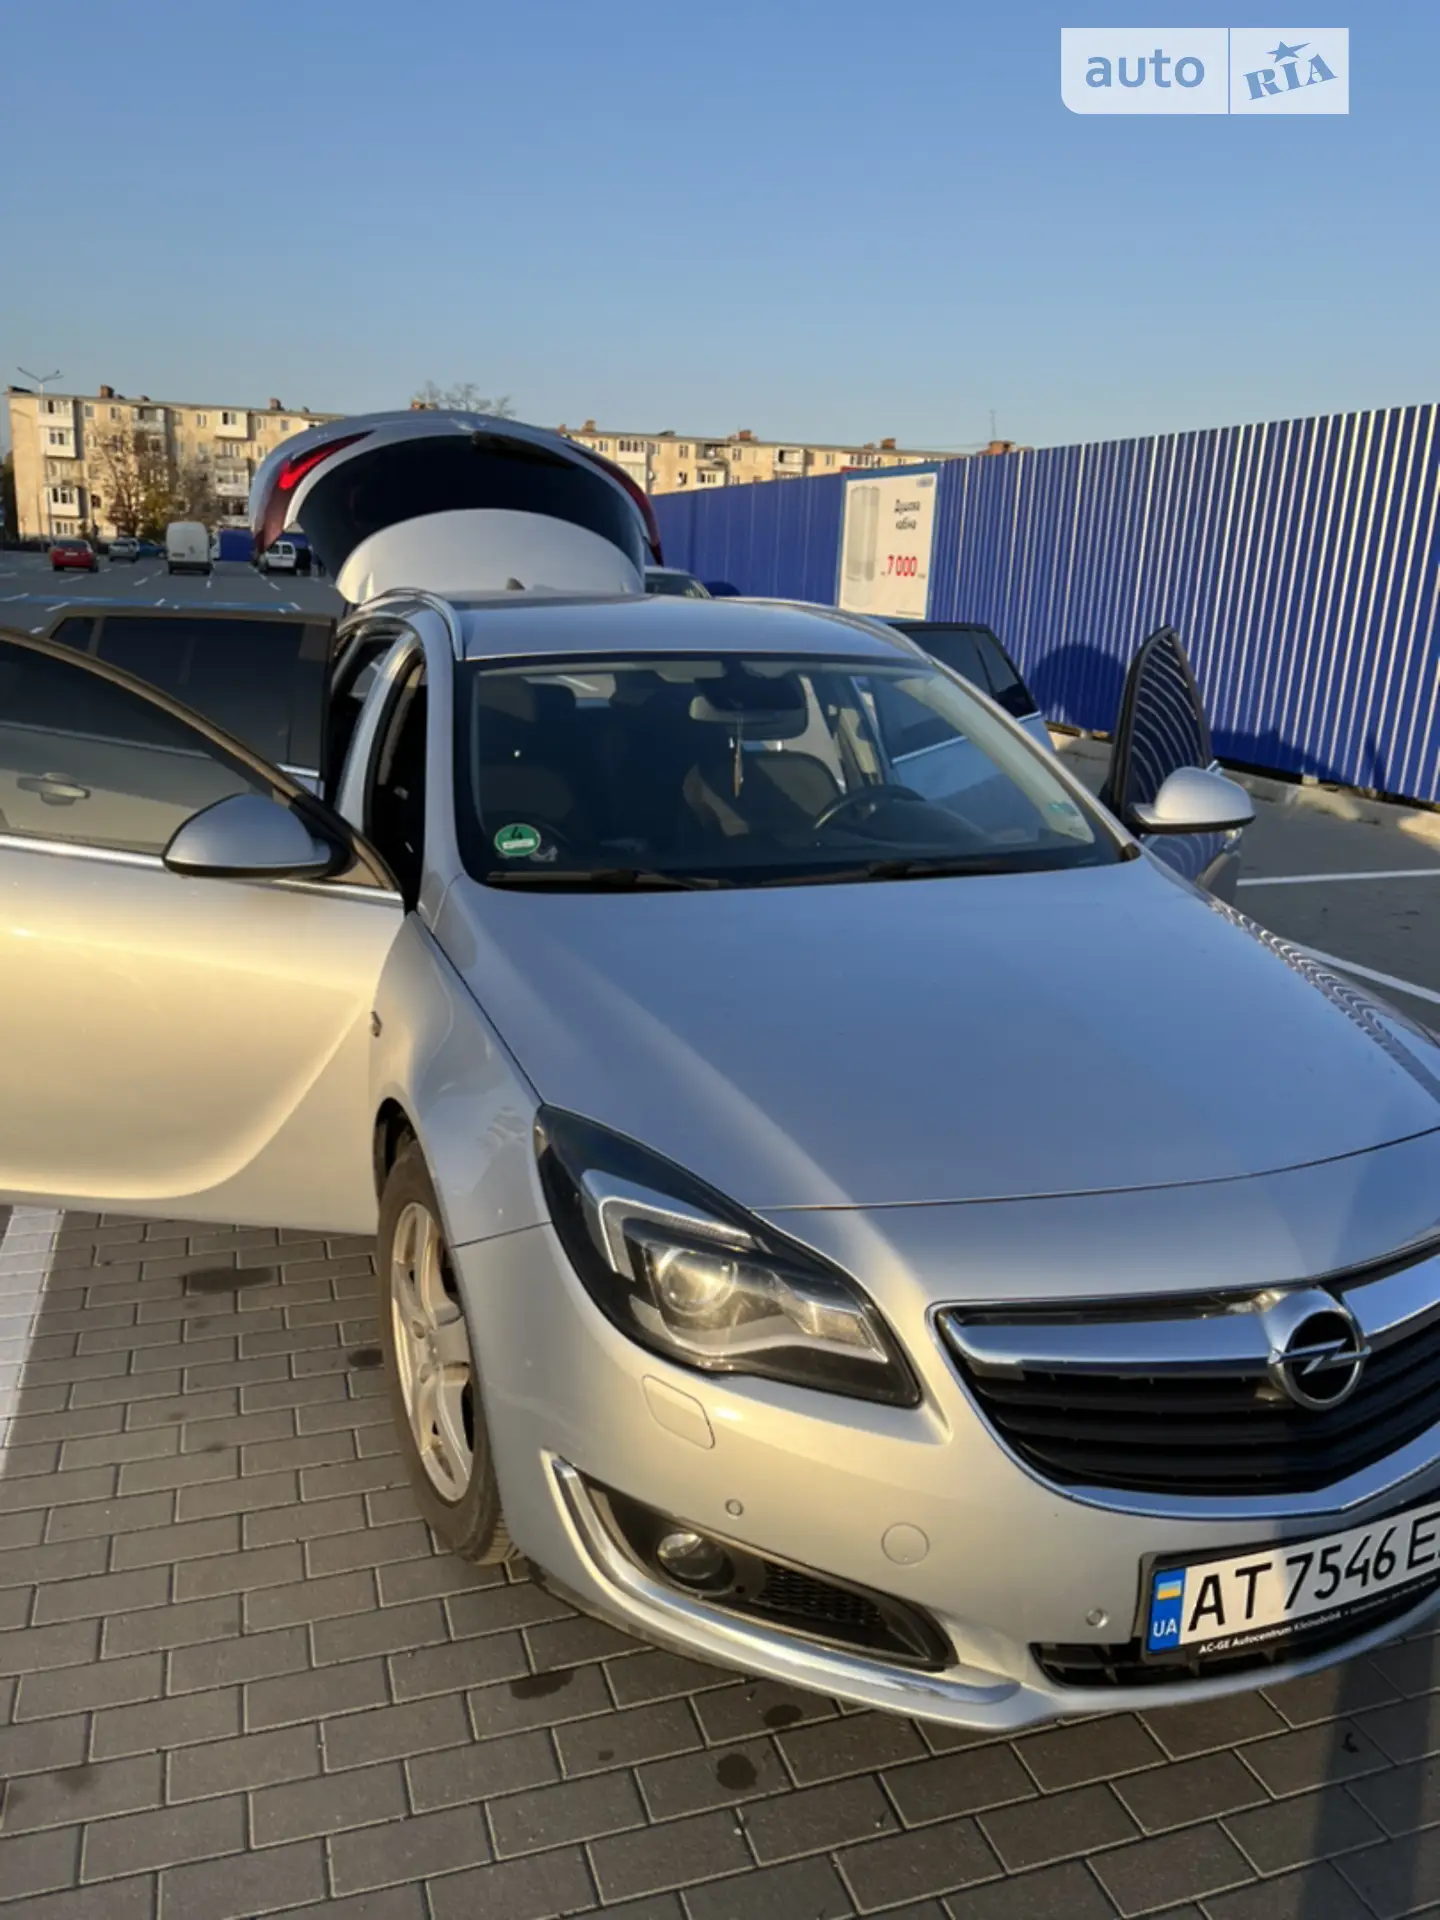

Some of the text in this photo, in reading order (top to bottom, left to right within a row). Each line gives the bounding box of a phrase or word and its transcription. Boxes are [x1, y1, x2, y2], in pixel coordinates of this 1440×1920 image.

[511, 826, 524, 840] 4
[1187, 1561, 1273, 1632] AT
[1284, 1526, 1398, 1610] 7546
[1406, 1511, 1440, 1571] E
[1153, 1618, 1178, 1638] UA
[1231, 1625, 1292, 1647] Autocentrum
